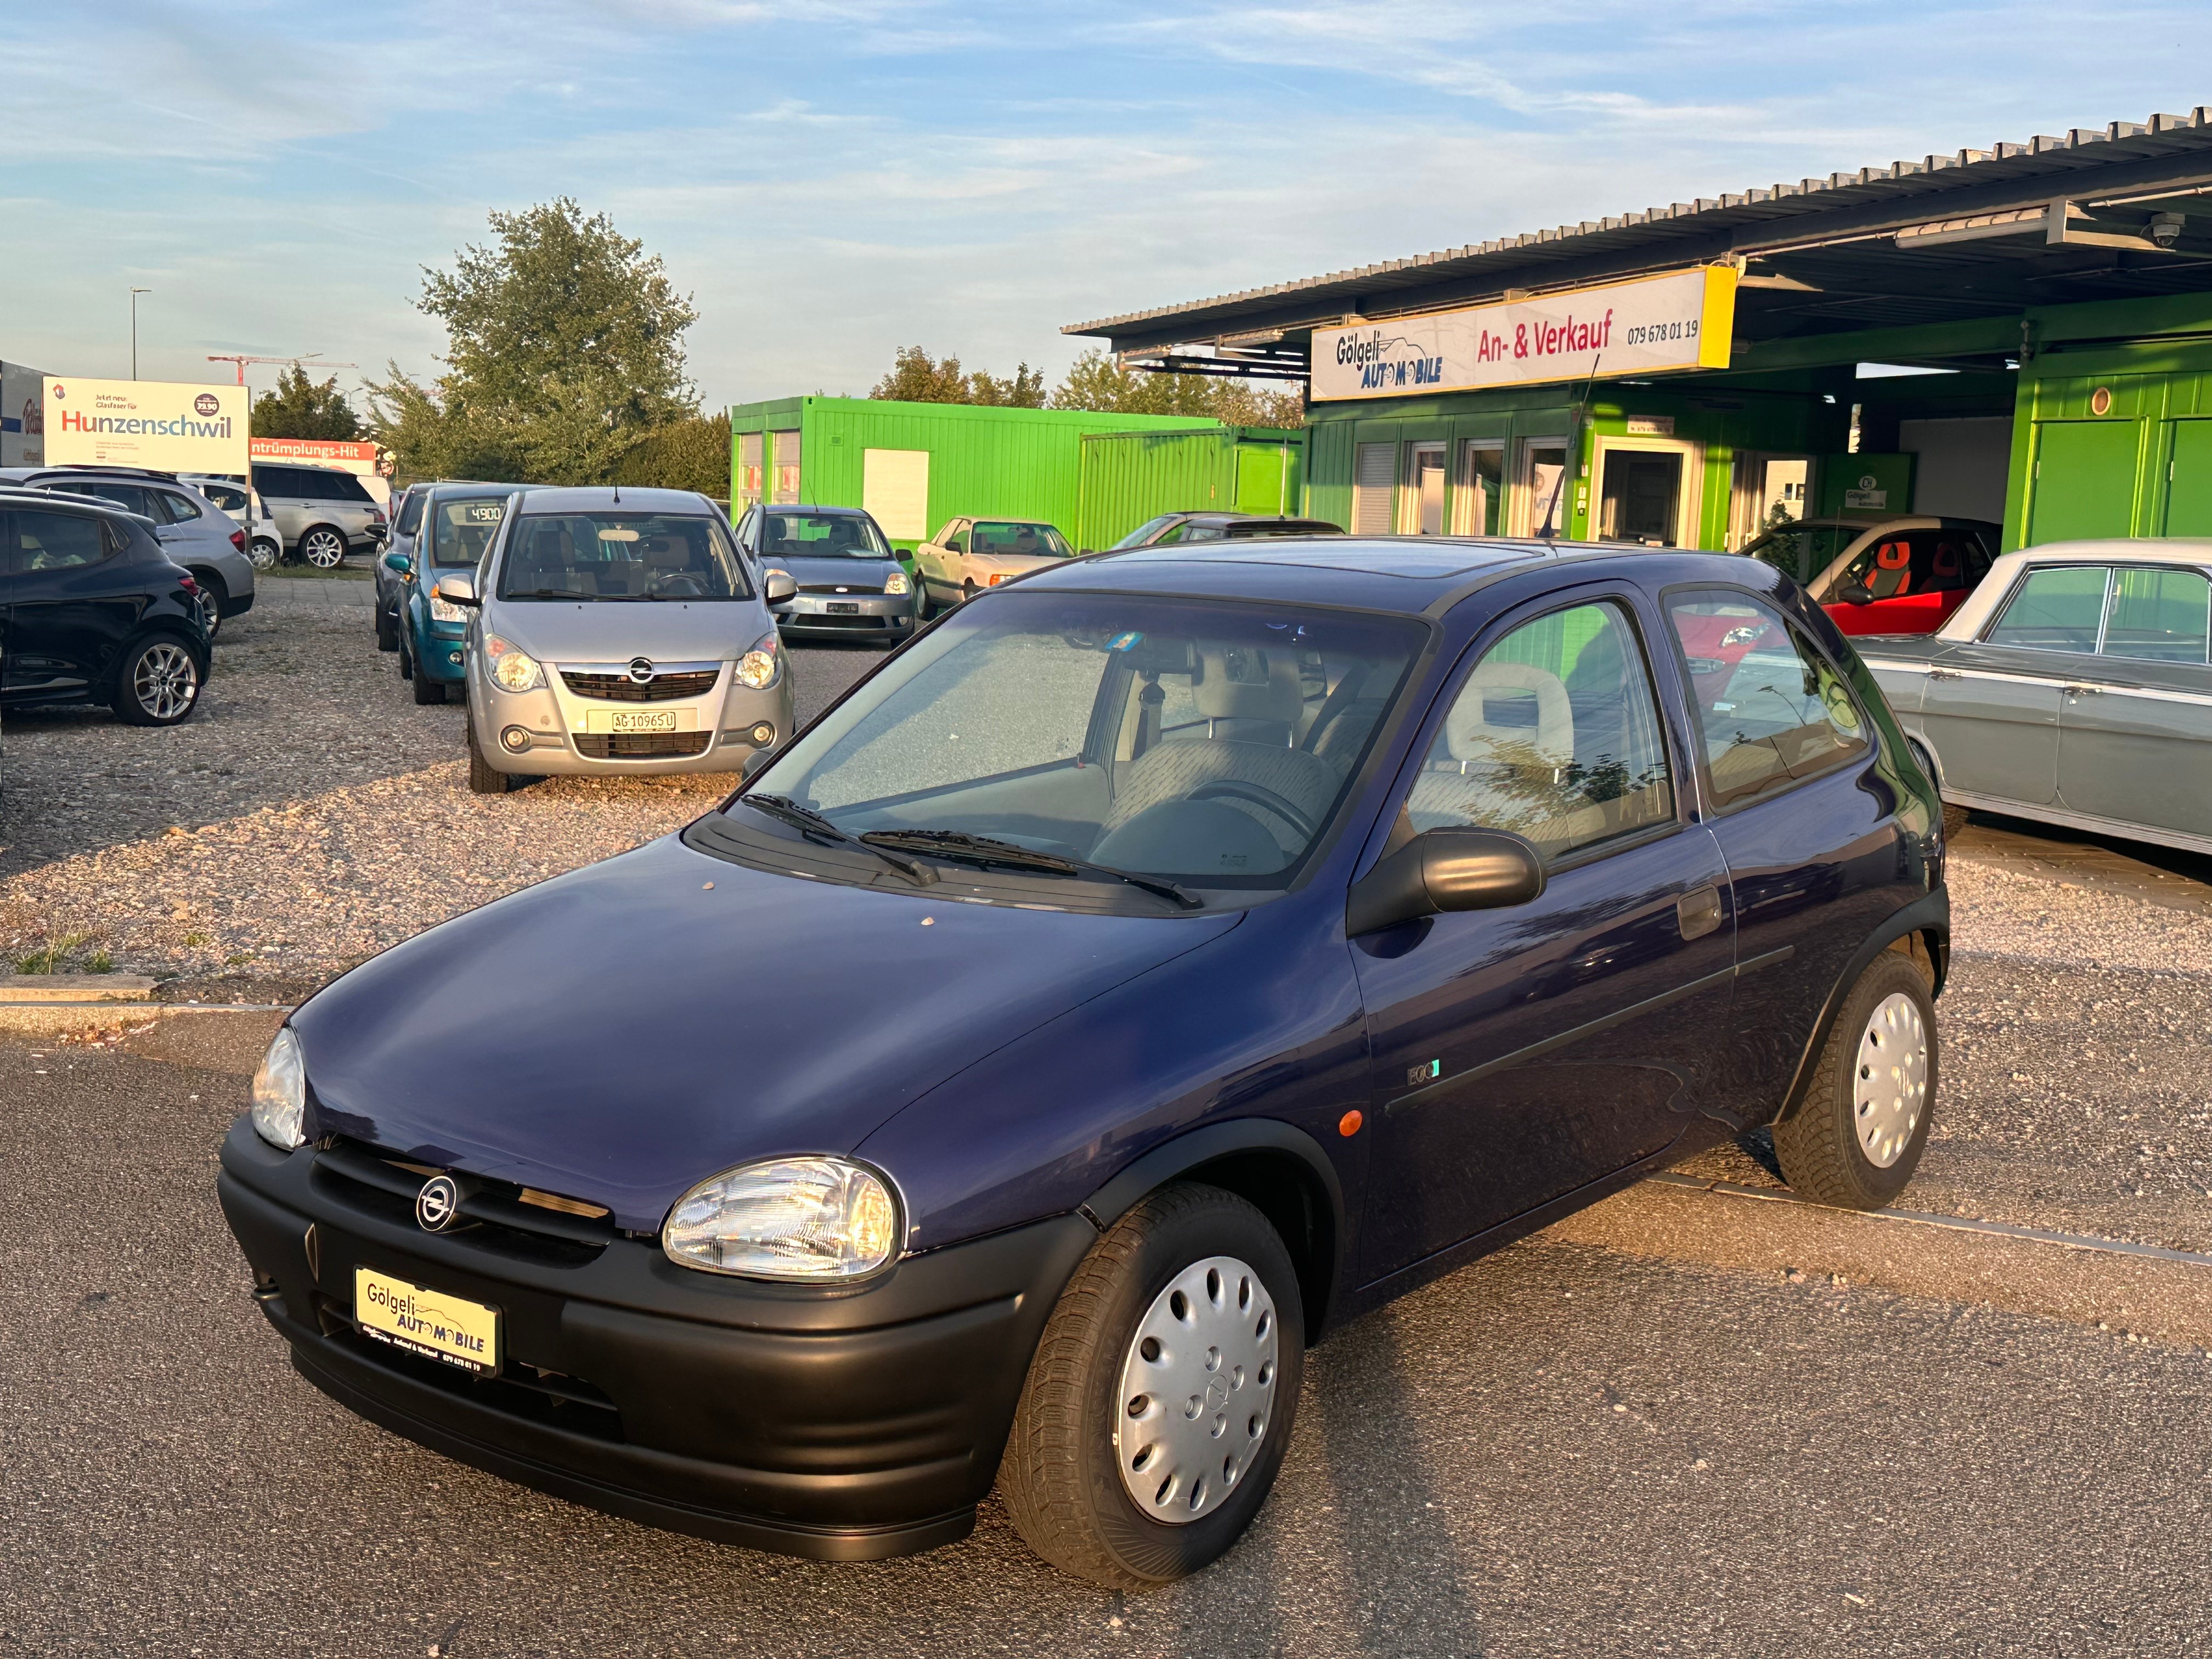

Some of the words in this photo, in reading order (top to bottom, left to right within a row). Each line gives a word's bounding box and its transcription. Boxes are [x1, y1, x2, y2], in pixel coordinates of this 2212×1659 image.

[1478, 330, 1508, 363] An-
[1514, 323, 1528, 359] &
[1534, 308, 1613, 356] Verkauf
[1628, 327, 1646, 345] 079
[1648, 324, 1667, 343] 678
[1669, 321, 1682, 340] 01
[1685, 319, 1699, 338] 19
[1336, 330, 1380, 371] Gölgeli
[62, 410, 231, 438] Hunzenschwil
[251, 443, 359, 459] ntrümplungs-Hit
[367, 1283, 415, 1315] Gölgeli
